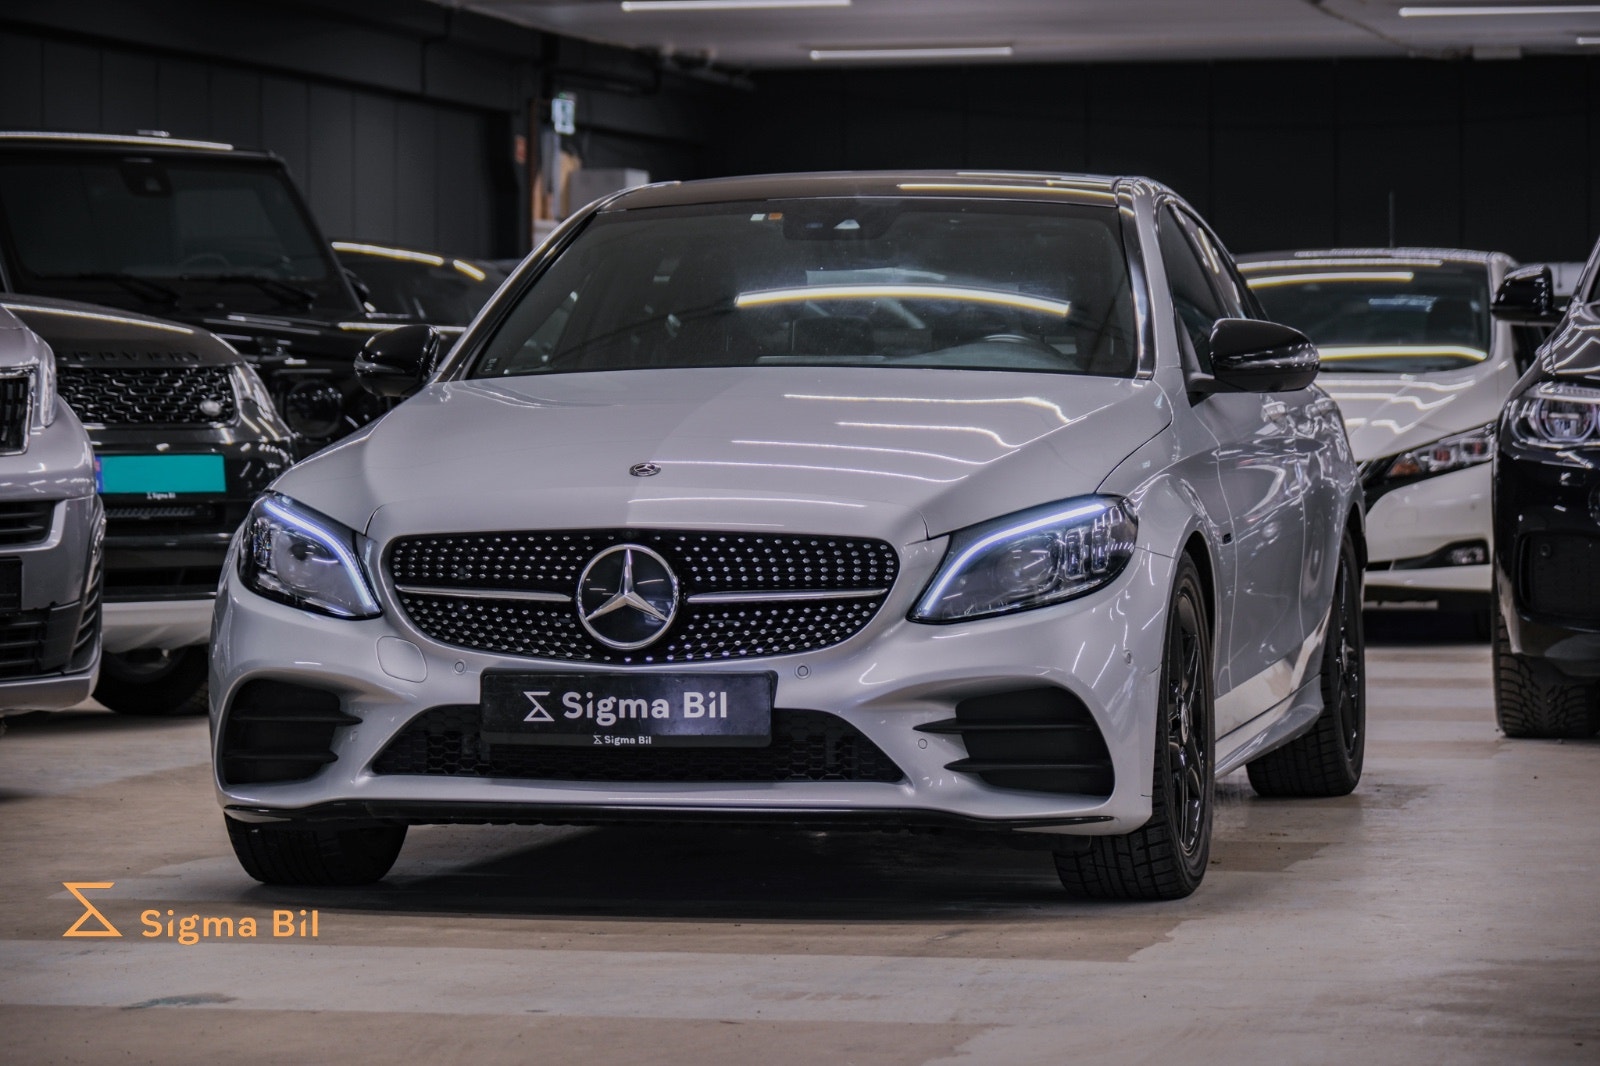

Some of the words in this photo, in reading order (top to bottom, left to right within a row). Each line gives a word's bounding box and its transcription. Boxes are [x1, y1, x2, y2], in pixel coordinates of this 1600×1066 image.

[562, 691, 670, 727] Sigma
[683, 691, 728, 719] Bil
[604, 735, 636, 746] Sigma
[638, 735, 652, 745] Bil
